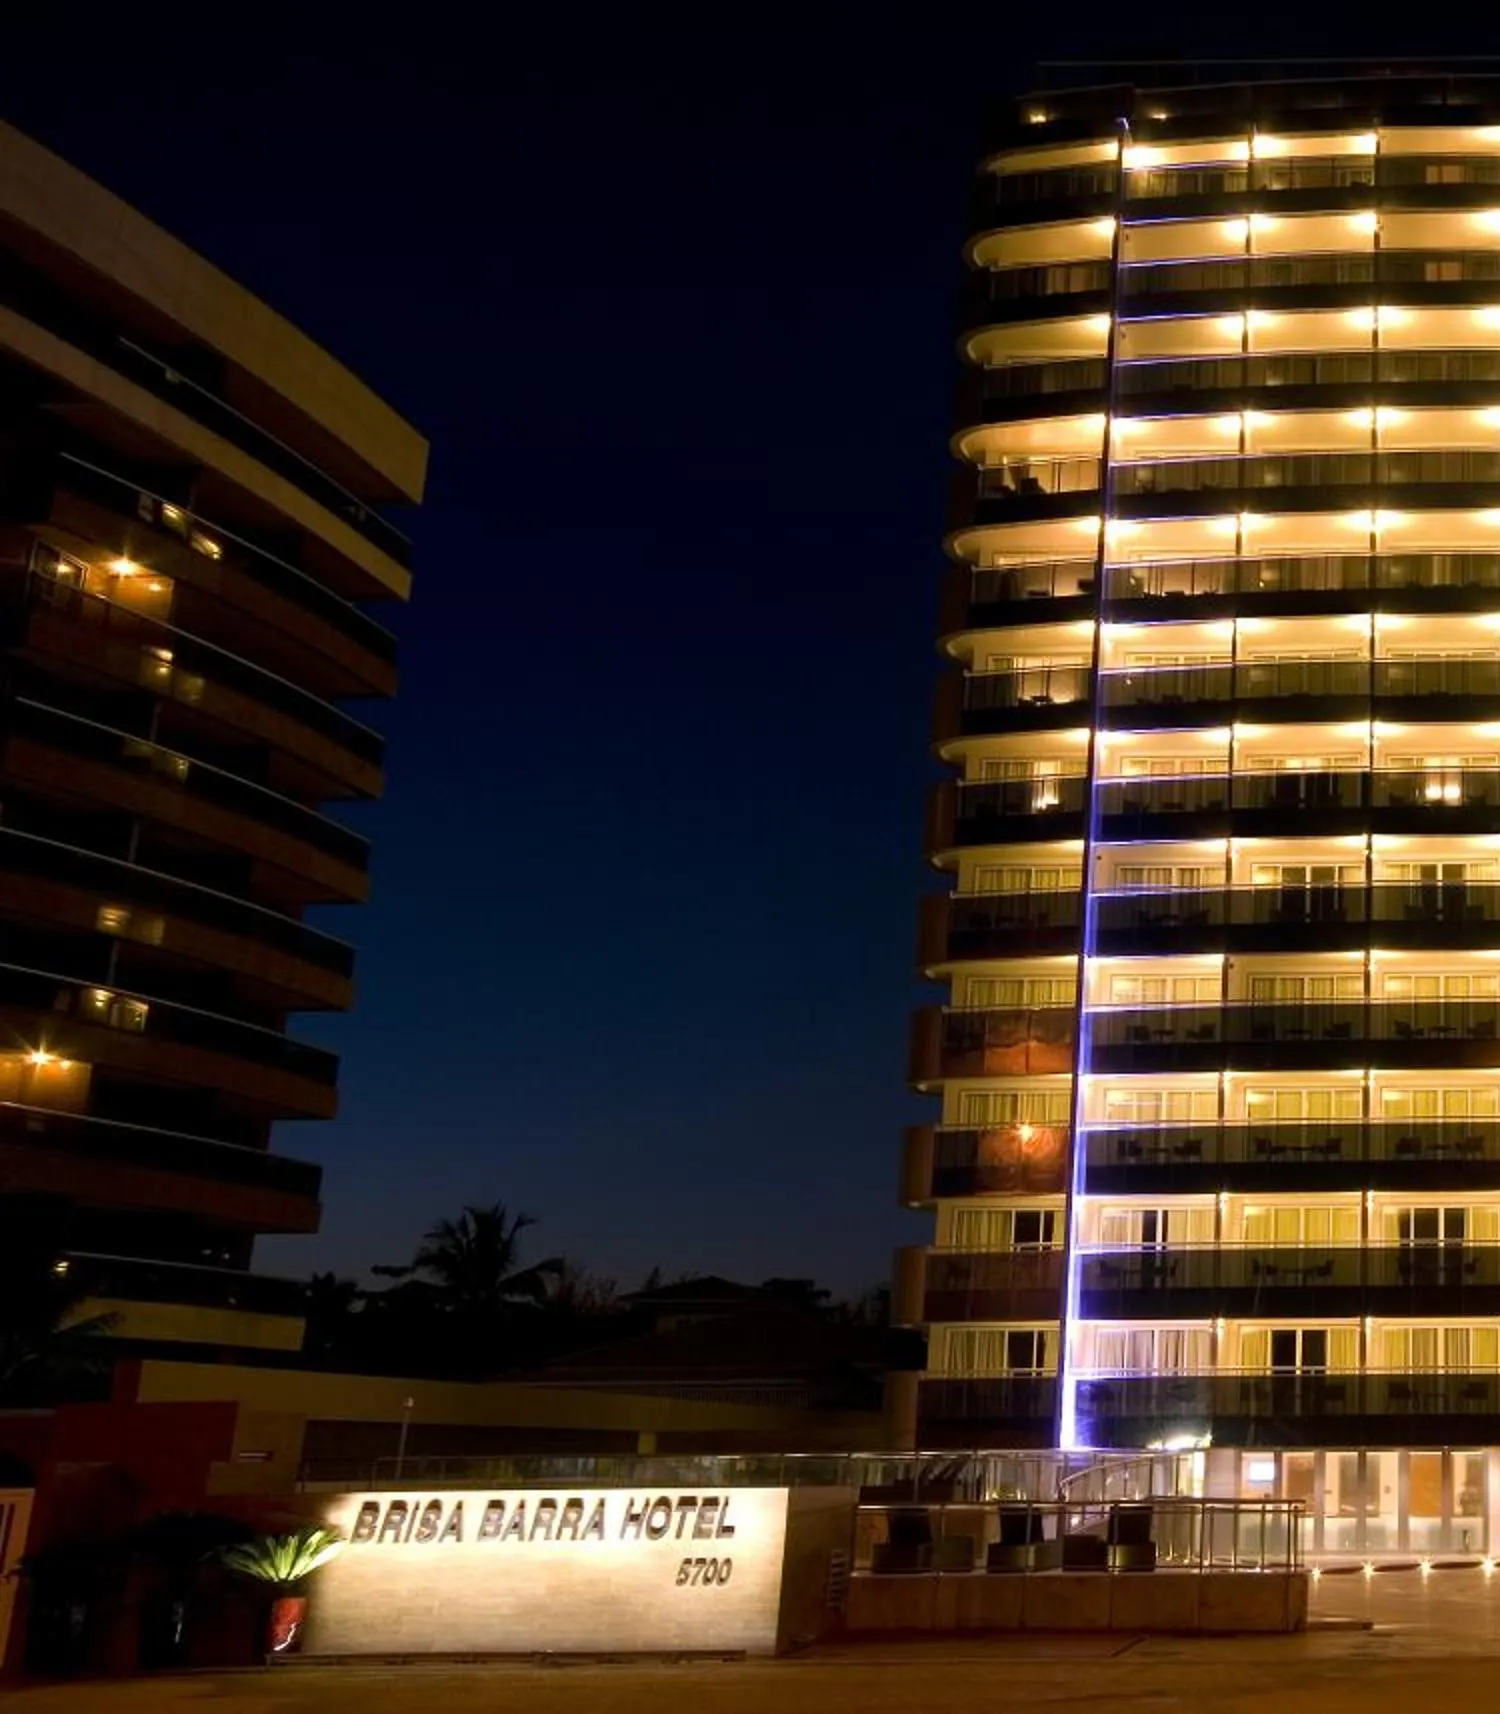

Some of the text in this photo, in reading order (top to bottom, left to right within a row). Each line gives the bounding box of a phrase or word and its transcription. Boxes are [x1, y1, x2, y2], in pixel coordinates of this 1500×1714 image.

[350, 1495, 735, 1543] BRISA BARRA HOTEL
[675, 1557, 732, 1586] 5700
